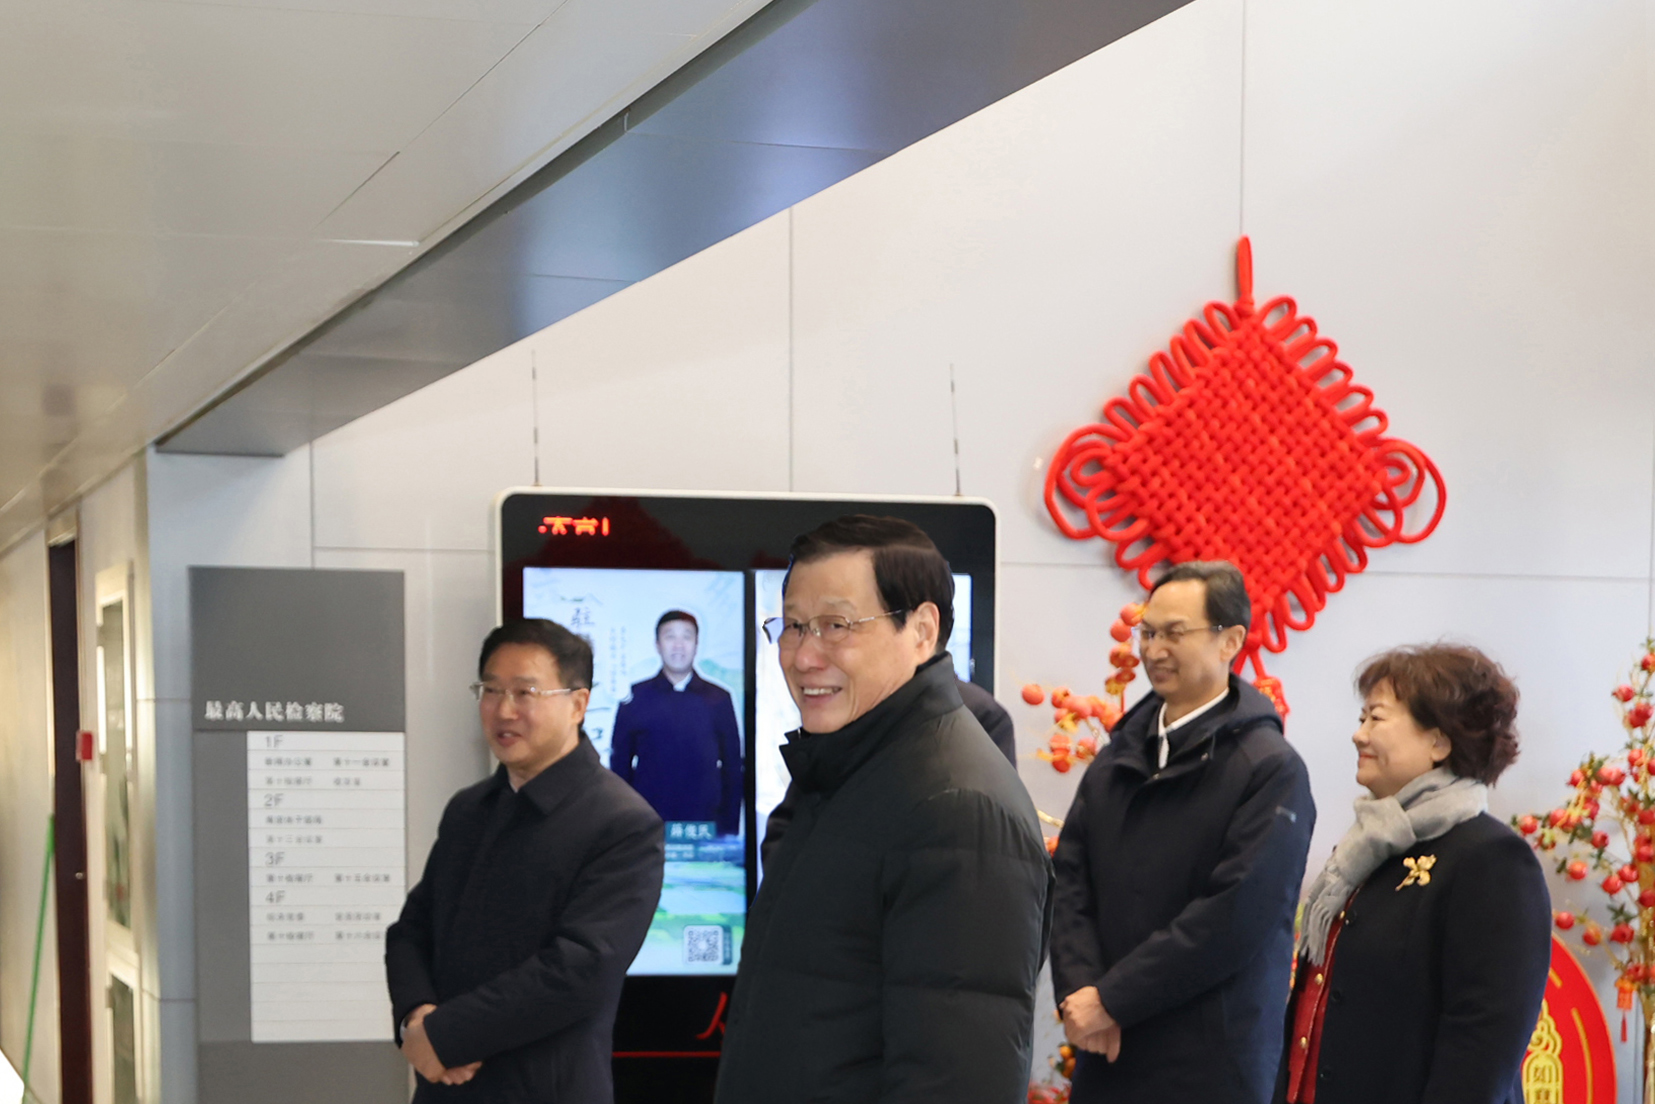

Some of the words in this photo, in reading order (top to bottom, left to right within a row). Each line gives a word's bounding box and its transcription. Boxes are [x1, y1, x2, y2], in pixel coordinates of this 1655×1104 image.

[205, 700, 345, 723] 最高人民检察院
[264, 734, 284, 749] 1F
[264, 792, 284, 808] 2F
[265, 851, 285, 866] 3F
[265, 889, 286, 904] 4F
